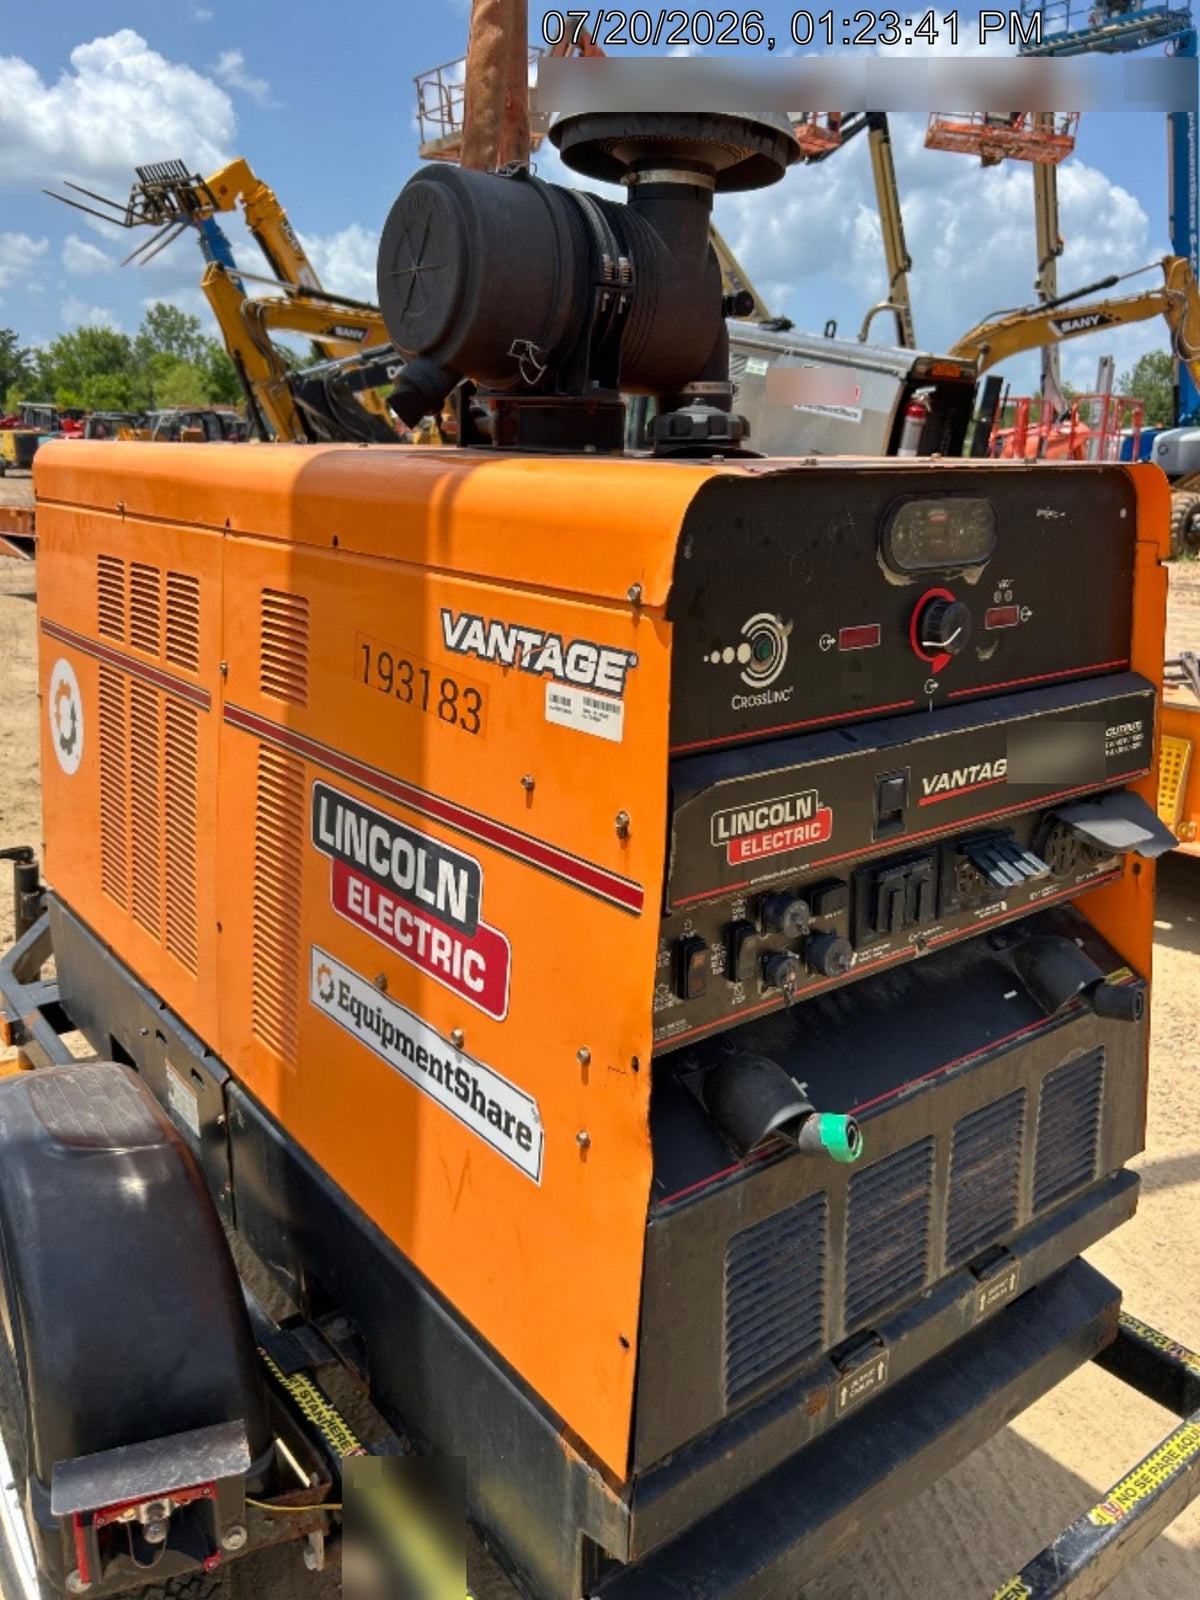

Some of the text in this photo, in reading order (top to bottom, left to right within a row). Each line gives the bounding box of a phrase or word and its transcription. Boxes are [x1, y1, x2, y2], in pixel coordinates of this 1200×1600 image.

[1060, 313, 1101, 333] SANY
[441, 609, 628, 695] VANTAGE
[361, 643, 483, 735] 193183
[922, 758, 1008, 796] VANTAG
[717, 796, 813, 840] LINCOLN
[740, 822, 822, 857] ELECTRIC
[318, 795, 469, 924] LINCOLN
[346, 876, 487, 994] ELECTRIC
[336, 978, 533, 1153] EquipmentShare
[1116, 1486, 1138, 1505] NO
[1133, 1473, 1153, 1490] SE
[1148, 1449, 1181, 1477] PARE
